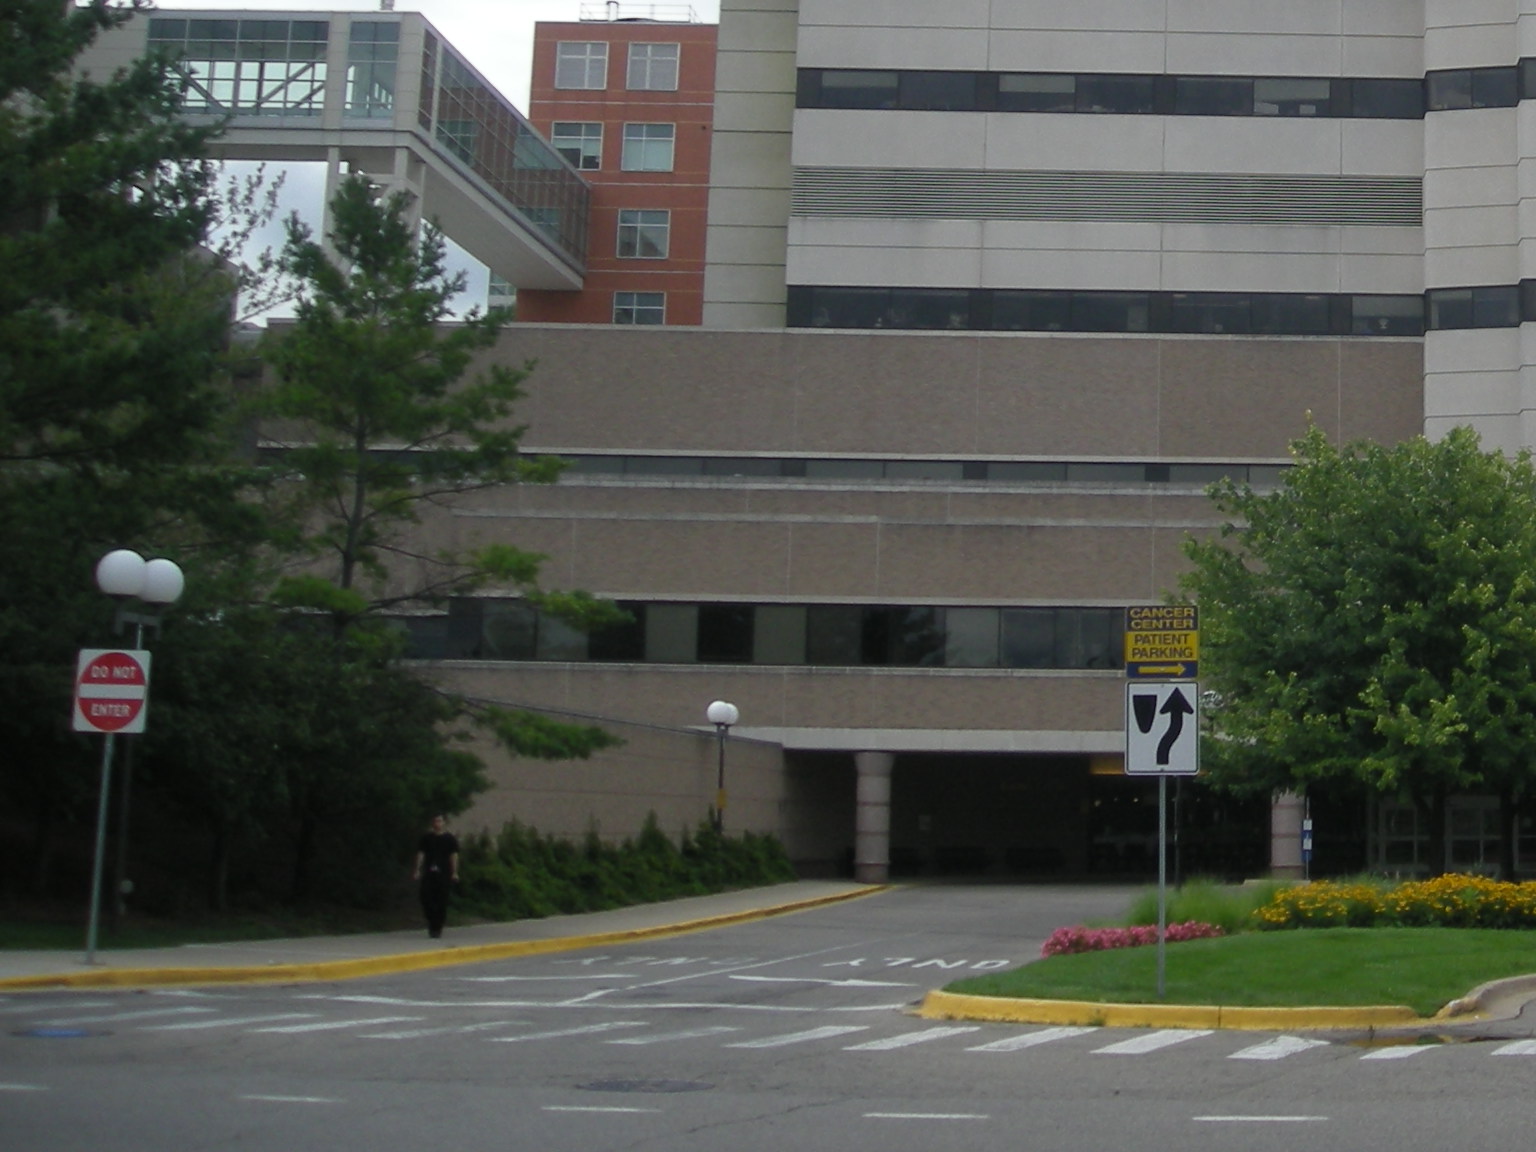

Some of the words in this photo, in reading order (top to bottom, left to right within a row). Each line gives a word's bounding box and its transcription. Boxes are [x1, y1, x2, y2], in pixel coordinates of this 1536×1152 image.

[1129, 607, 1195, 618] CANCER
[1131, 619, 1194, 629] CENTER
[1134, 633, 1190, 645] PATIENT
[1131, 647, 1193, 659] PARKING
[90, 665, 109, 679] DO
[112, 666, 136, 679] NOT
[90, 703, 131, 717] ENTER
[822, 957, 1010, 969] ONLY
